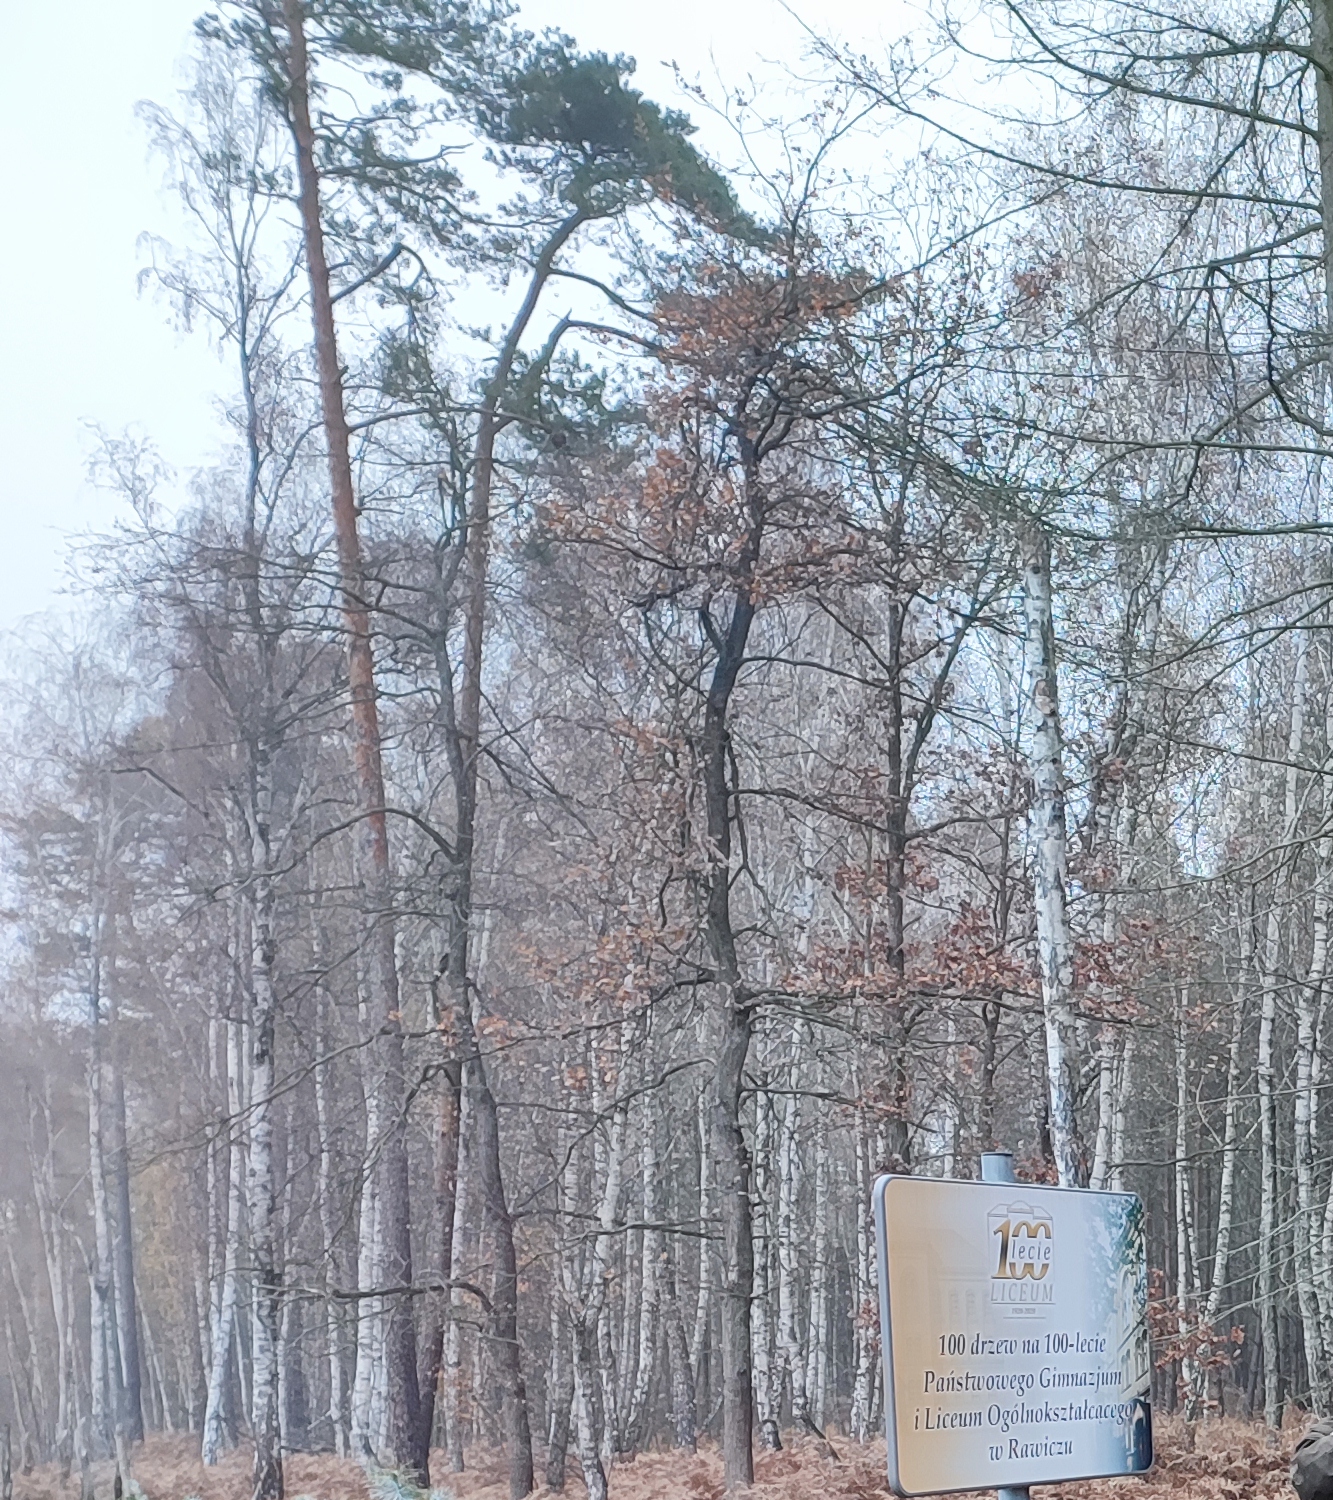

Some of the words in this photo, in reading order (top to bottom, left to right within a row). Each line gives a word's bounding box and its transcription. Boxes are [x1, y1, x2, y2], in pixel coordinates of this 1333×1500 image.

[991, 1219, 1052, 1280] 100
[1011, 1239, 1051, 1260] lecie
[990, 1282, 1054, 1302] LICEUM
[939, 1333, 966, 1356] 100
[970, 1332, 1018, 1355] drzew
[1022, 1338, 1040, 1354] na
[1044, 1331, 1106, 1354] 100-lecie
[923, 1369, 1035, 1397] Państwowego
[1039, 1366, 1122, 1394] Gimnazjum
[914, 1408, 920, 1431] i
[925, 1406, 982, 1430] Liceum
[987, 1399, 1133, 1433] Ogólnokształcącego
[989, 1445, 1004, 1461] w
[1008, 1435, 1073, 1460] Rawiczu
